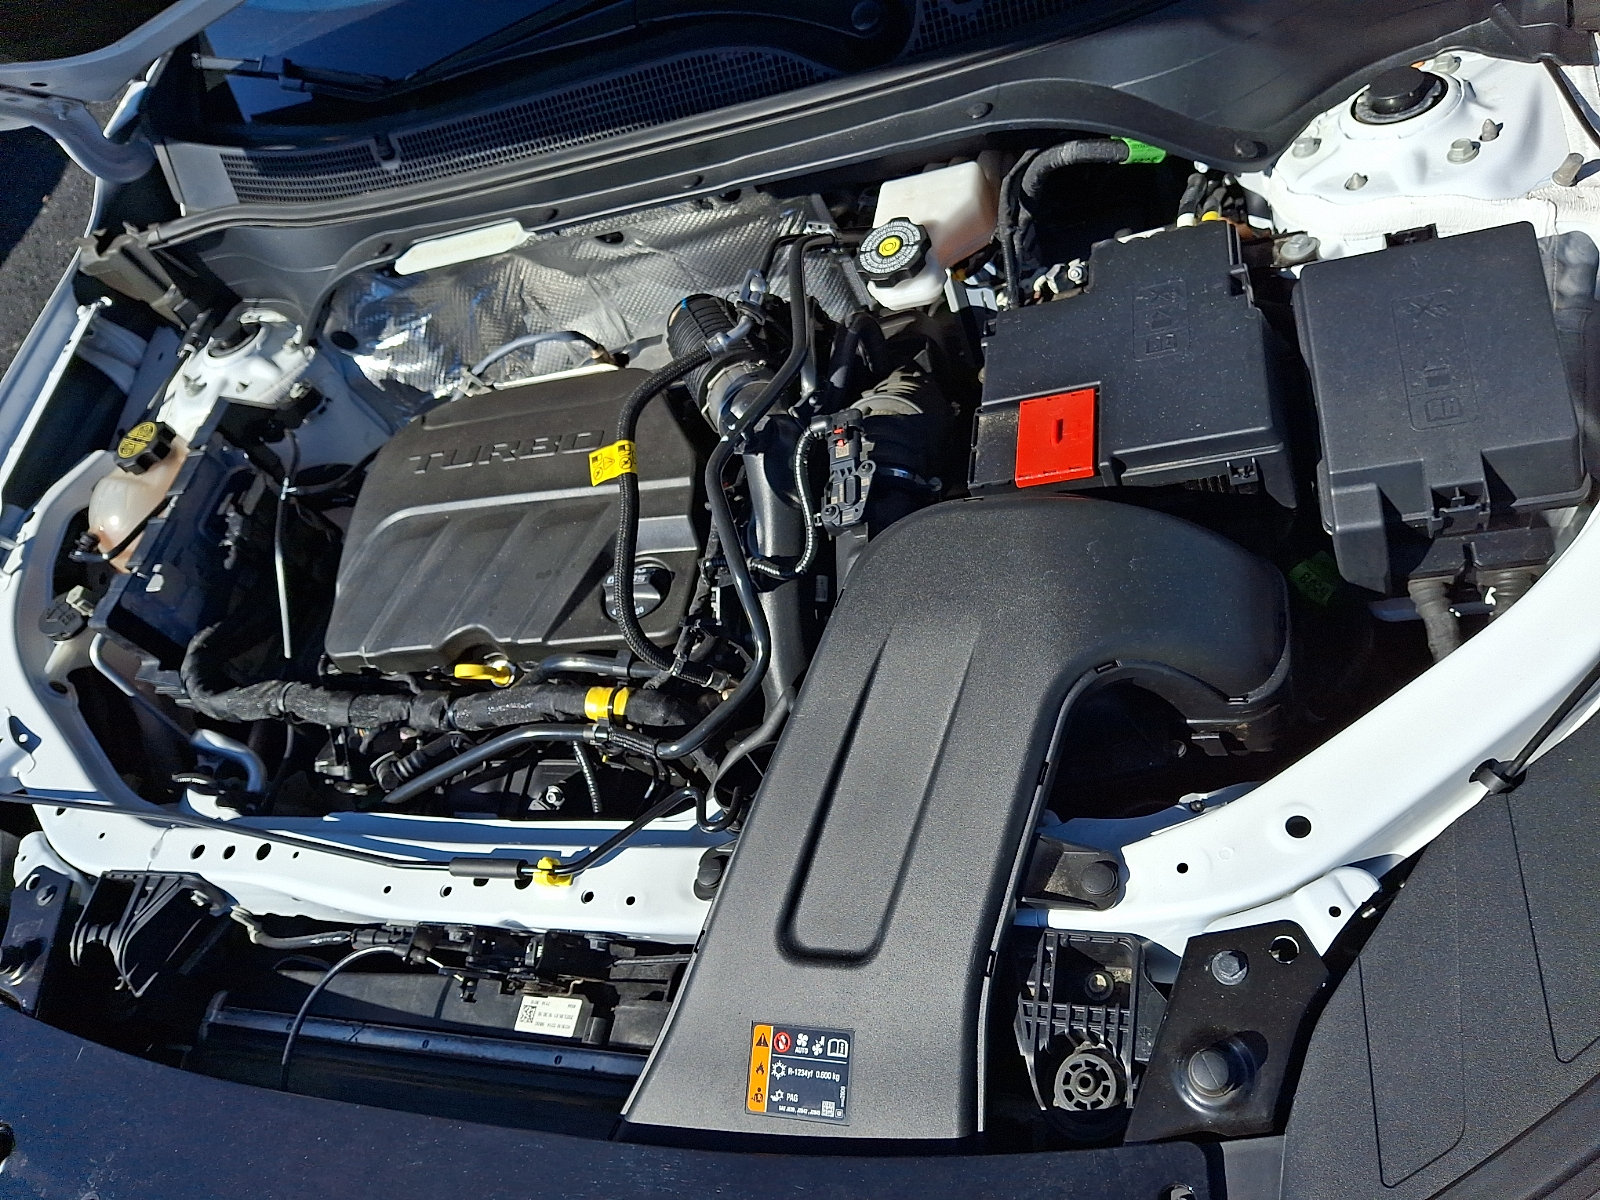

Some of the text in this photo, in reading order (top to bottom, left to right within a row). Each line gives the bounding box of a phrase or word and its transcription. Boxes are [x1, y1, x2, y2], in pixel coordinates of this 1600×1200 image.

[409, 430, 604, 474] TURBO
[794, 1046, 809, 1054] AUTO
[787, 1067, 813, 1079] R-1234yf
[832, 1072, 840, 1082] kg
[786, 1093, 799, 1102] PAG
